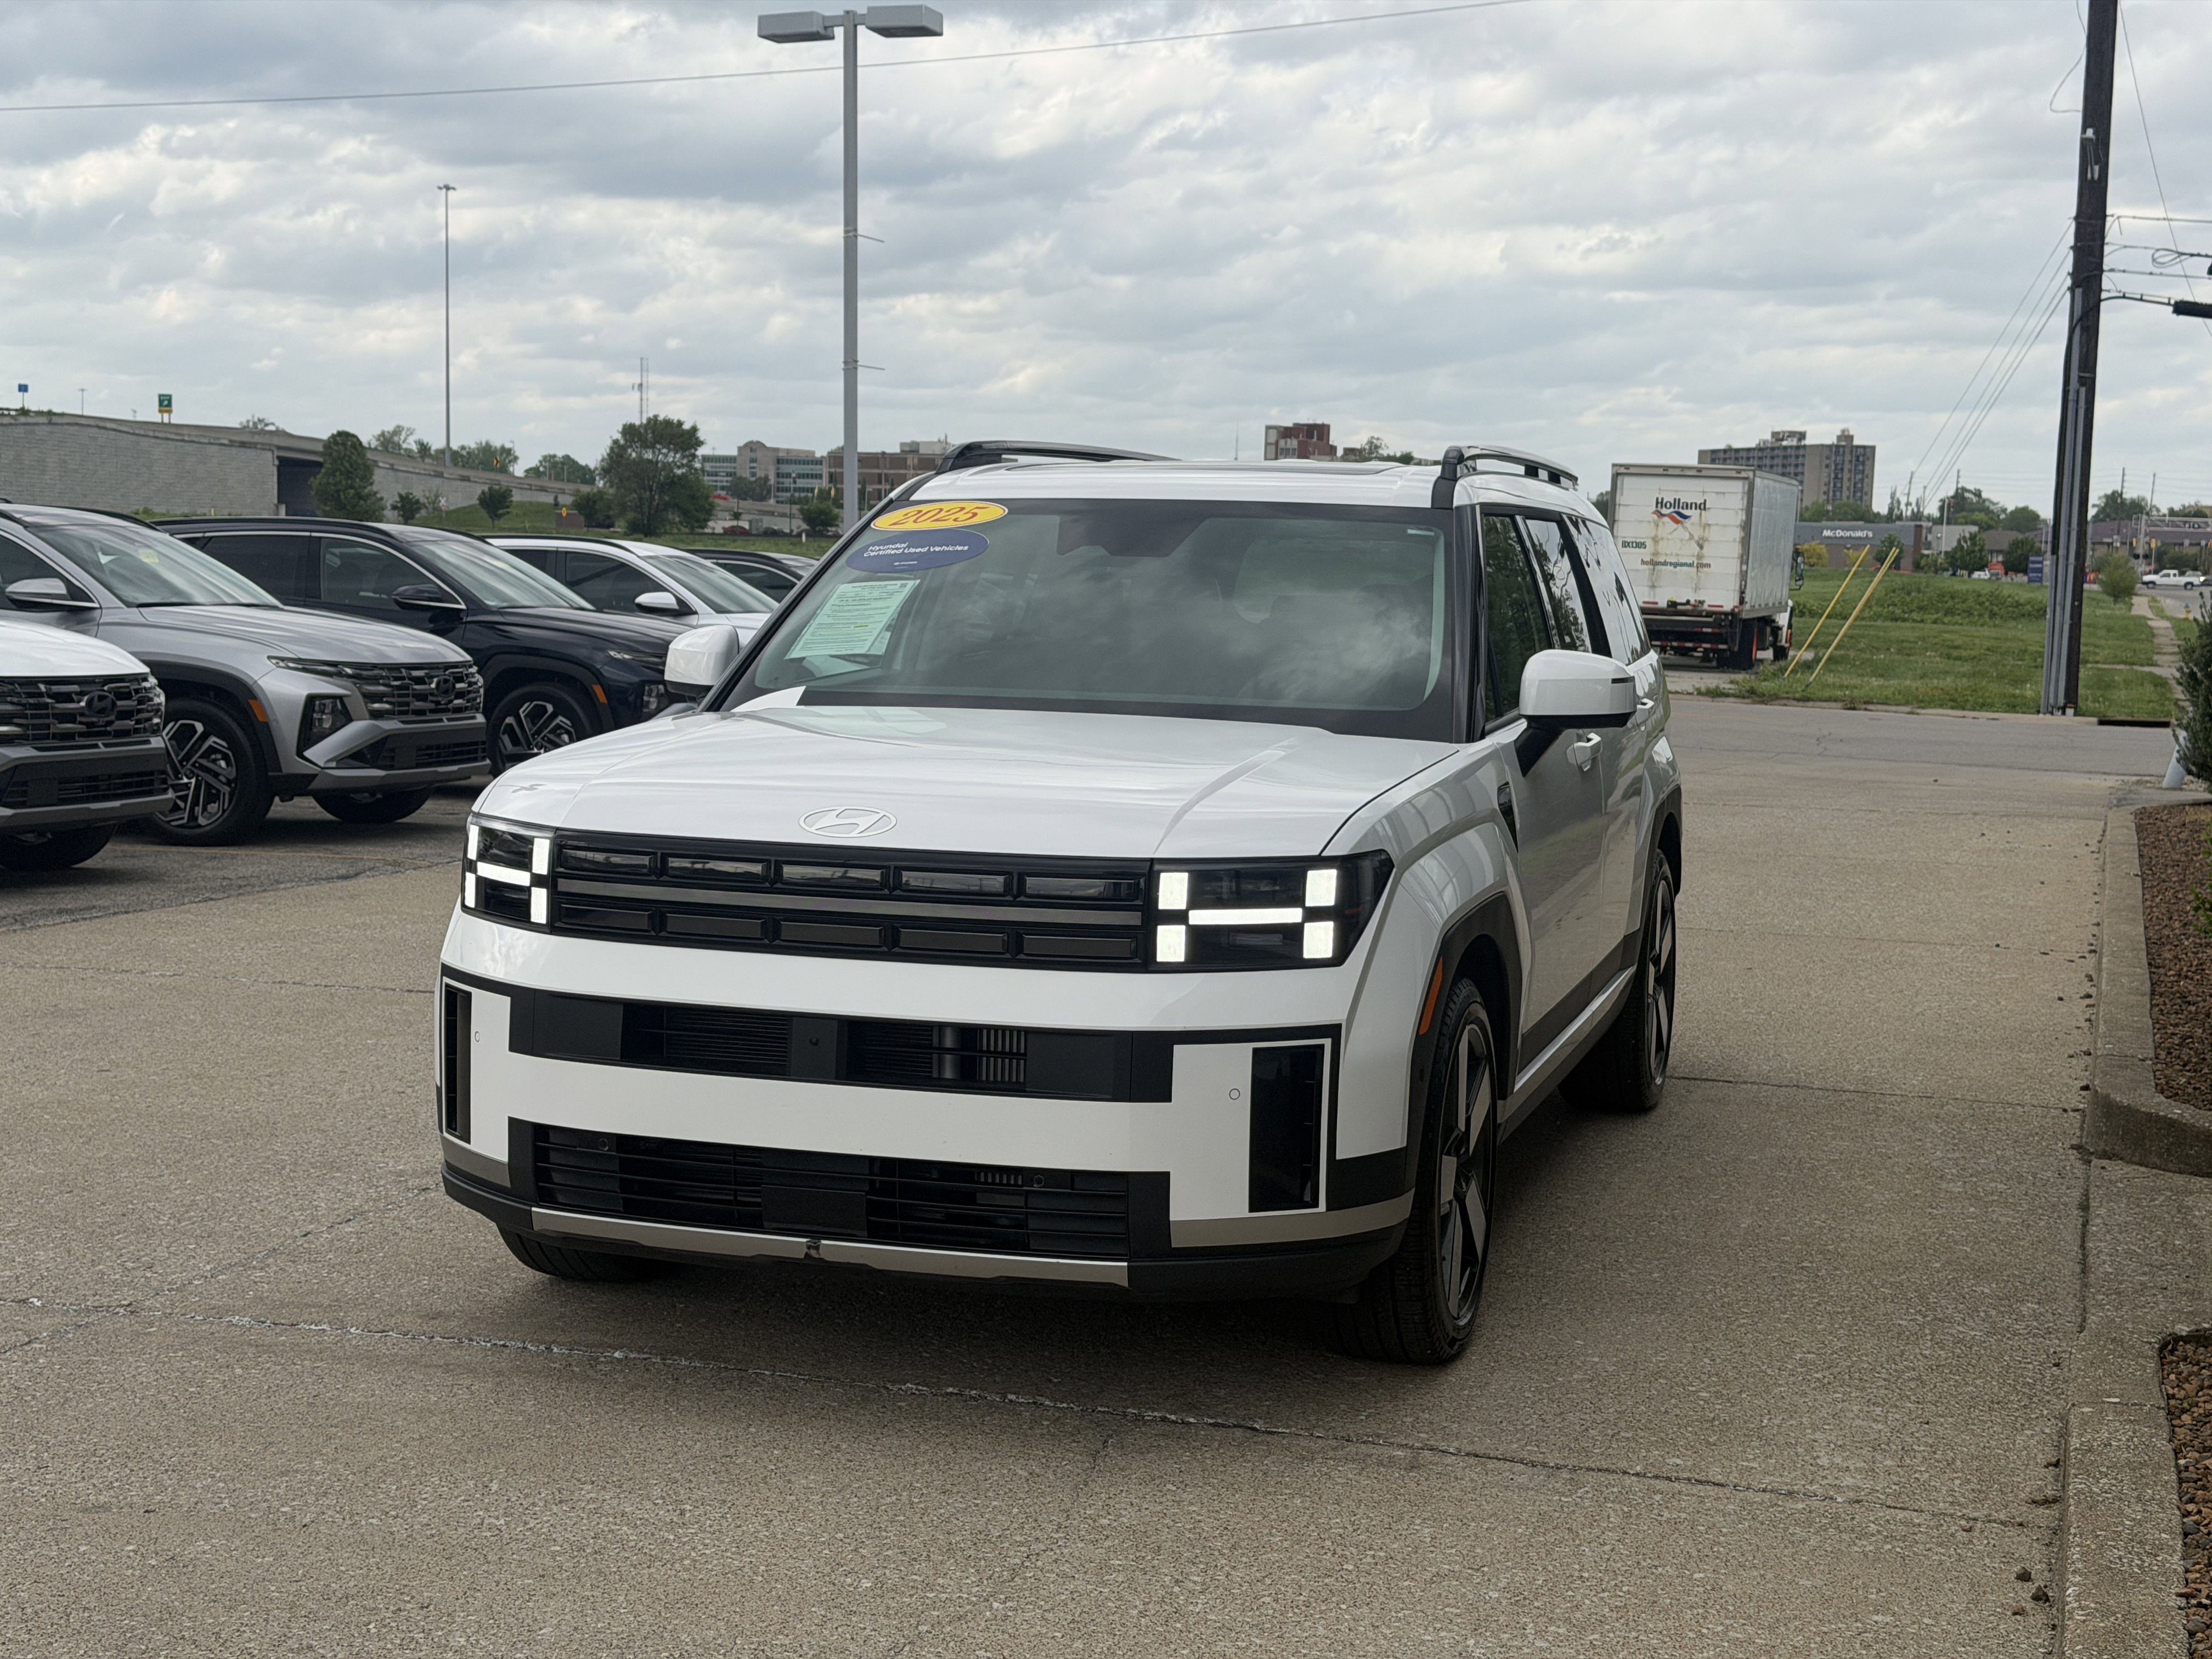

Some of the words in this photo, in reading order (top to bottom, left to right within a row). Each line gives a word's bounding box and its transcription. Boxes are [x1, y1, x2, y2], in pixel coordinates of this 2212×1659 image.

[1656, 496, 1707, 511] Holland
[888, 506, 989, 526] 2025
[1822, 529, 1873, 538] McDonald's
[868, 542, 909, 551] Hyundai
[1621, 540, 1647, 549] BX1305
[864, 548, 904, 557] Certified
